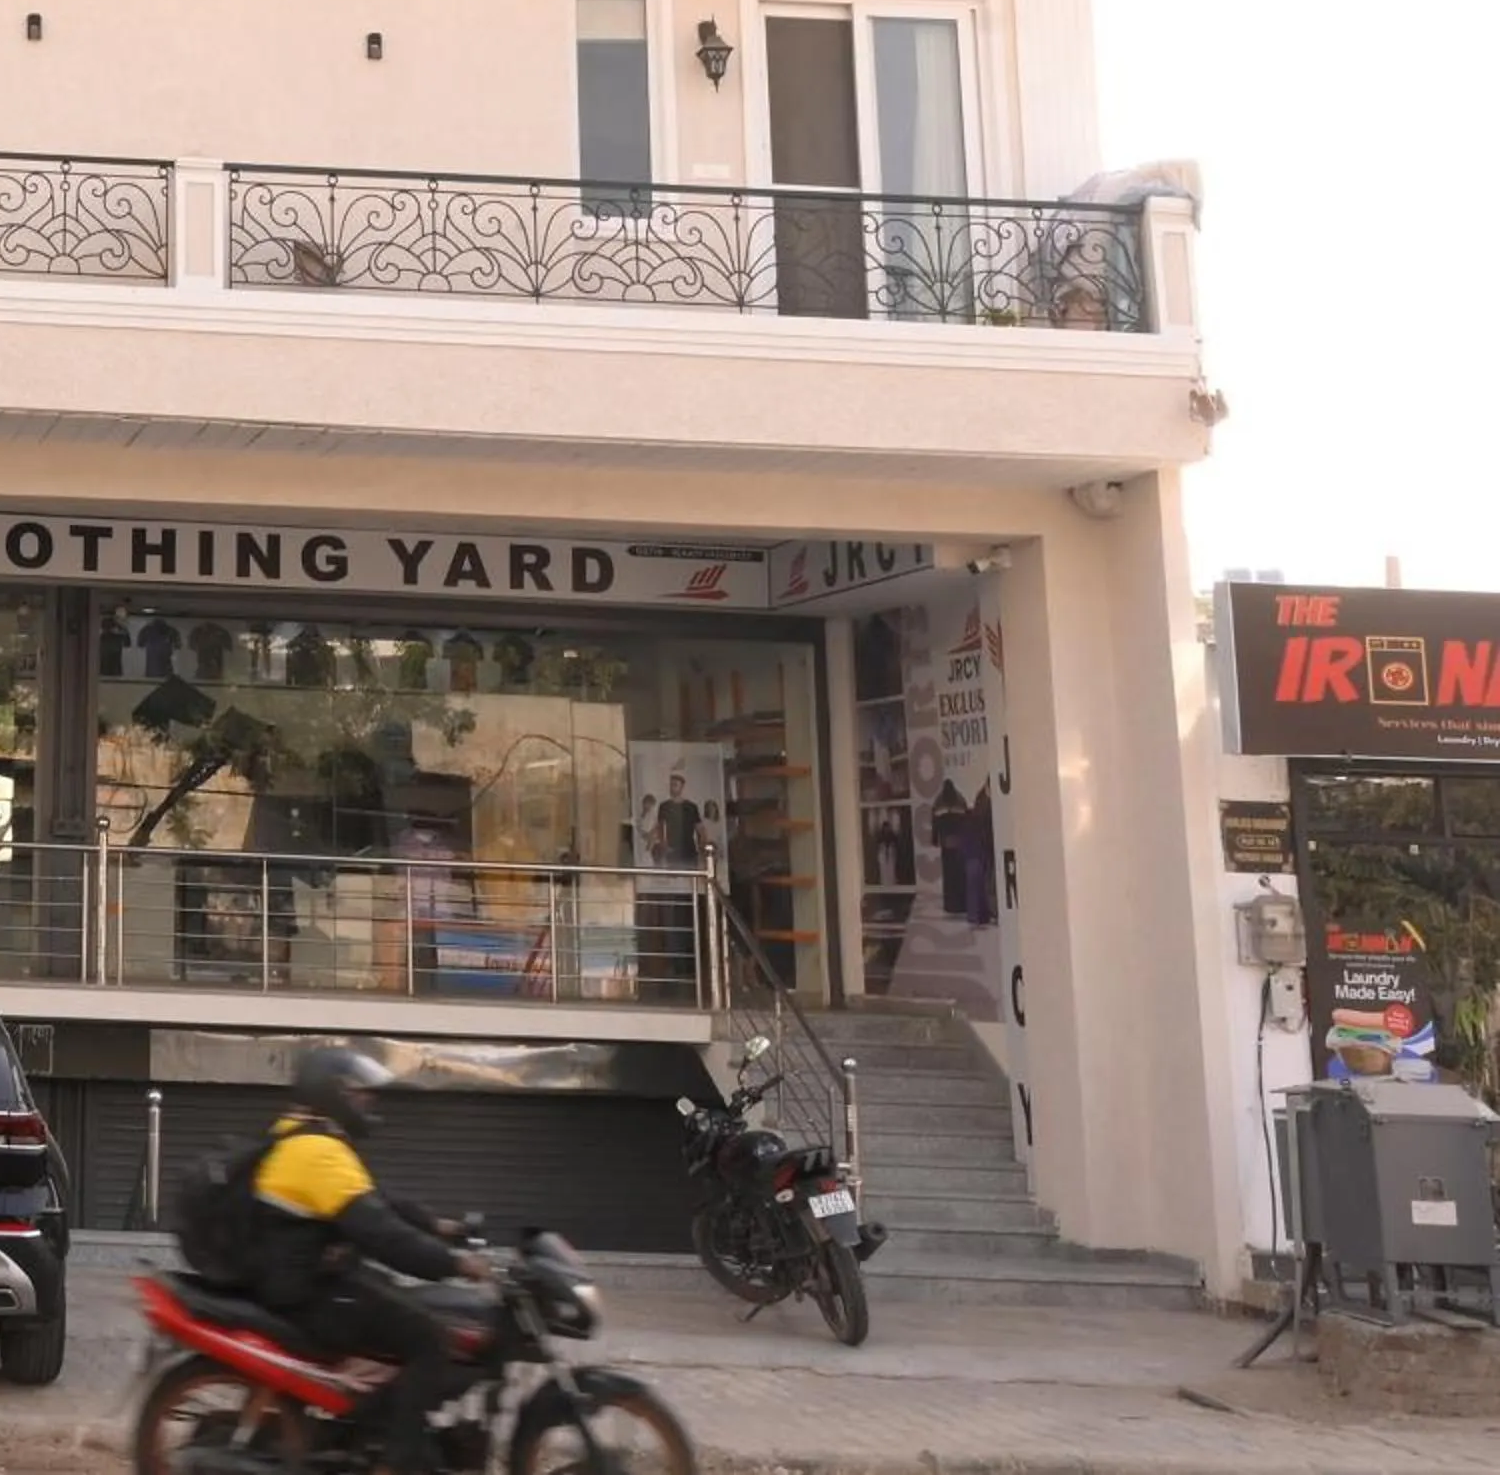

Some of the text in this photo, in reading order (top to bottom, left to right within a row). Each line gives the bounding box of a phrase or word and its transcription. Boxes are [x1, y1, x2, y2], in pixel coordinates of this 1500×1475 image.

[387, 538, 615, 593] YARD
[1276, 595, 1340, 626] THE
[948, 655, 981, 681] JRCY
[939, 689, 986, 717] EXCLUS
[941, 716, 989, 749] SPORT
[1342, 969, 1400, 988] Laundry
[1334, 984, 1415, 1004] Made Easy!
